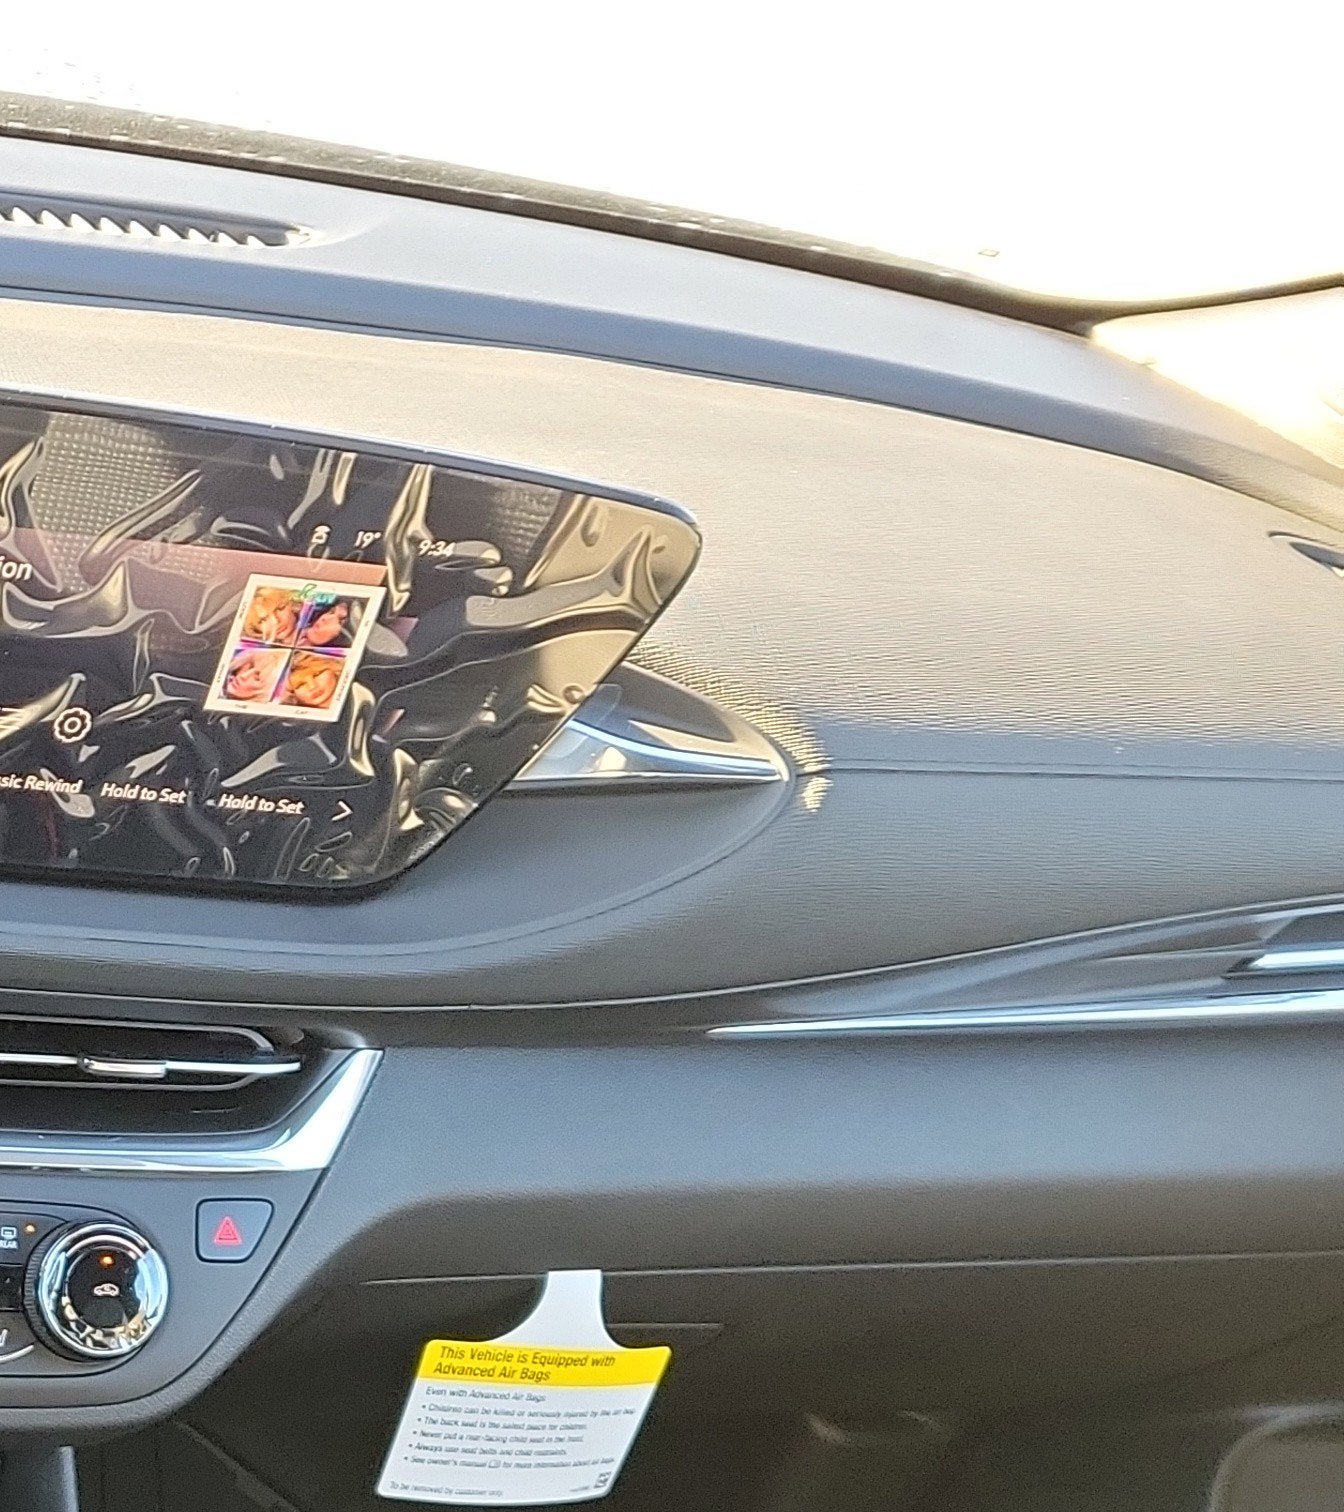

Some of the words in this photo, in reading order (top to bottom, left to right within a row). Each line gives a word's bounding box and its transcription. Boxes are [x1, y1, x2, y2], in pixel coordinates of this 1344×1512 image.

[25, 774, 84, 795] Rewind
[100, 782, 139, 800] Hold
[140, 787, 157, 801] to
[158, 788, 188, 804] Set
[218, 794, 257, 811] Hold
[258, 798, 275, 813] to
[276, 799, 306, 815] Set
[440, 1346, 466, 1360] This
[469, 1348, 515, 1363] Vehicle
[516, 1350, 529, 1364] is
[531, 1351, 589, 1368] Equipped
[590, 1355, 617, 1367] with
[432, 1361, 497, 1378] Advanced
[498, 1365, 518, 1379] Air
[520, 1367, 552, 1383] Bags
[425, 1386, 447, 1397] Even
[469, 1389, 511, 1400] Advanced
